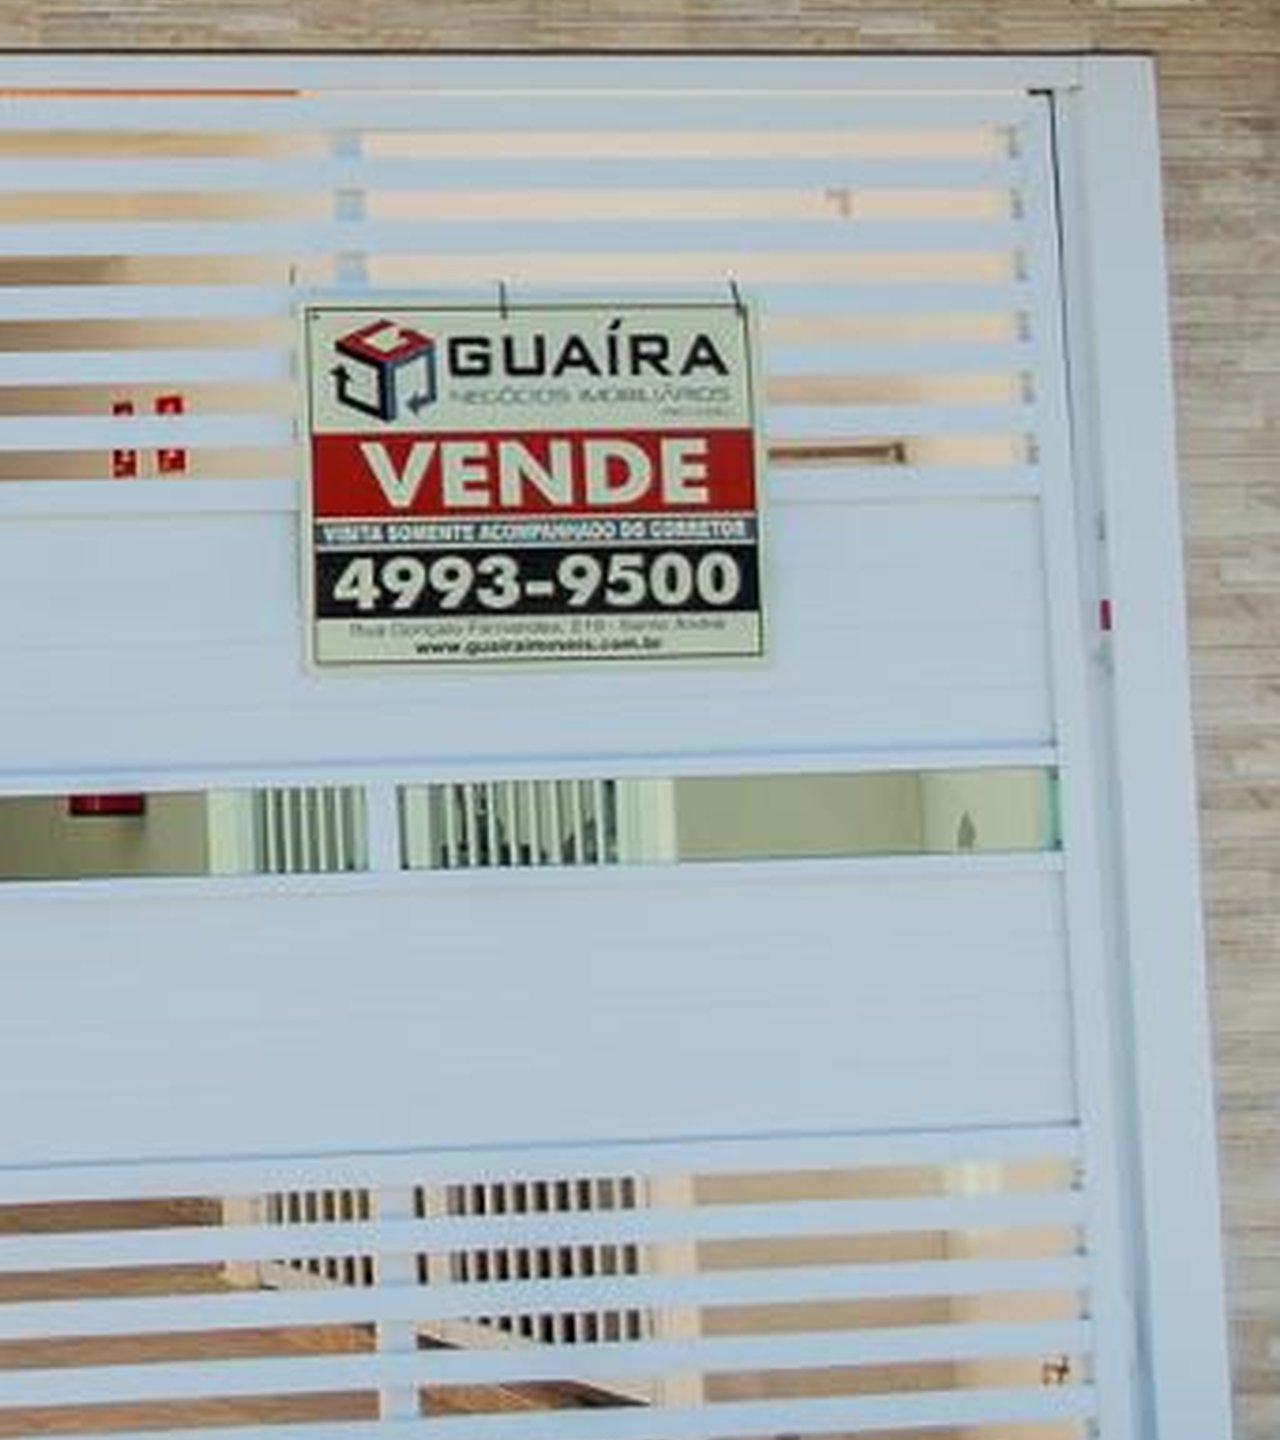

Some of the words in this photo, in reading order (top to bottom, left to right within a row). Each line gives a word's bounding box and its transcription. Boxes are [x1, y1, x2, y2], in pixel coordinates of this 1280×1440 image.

[448, 319, 730, 377] GUAÍRA
[360, 438, 711, 508] VENDE
[389, 522, 475, 542] SOMENTE
[333, 552, 741, 610] 4993-9500
